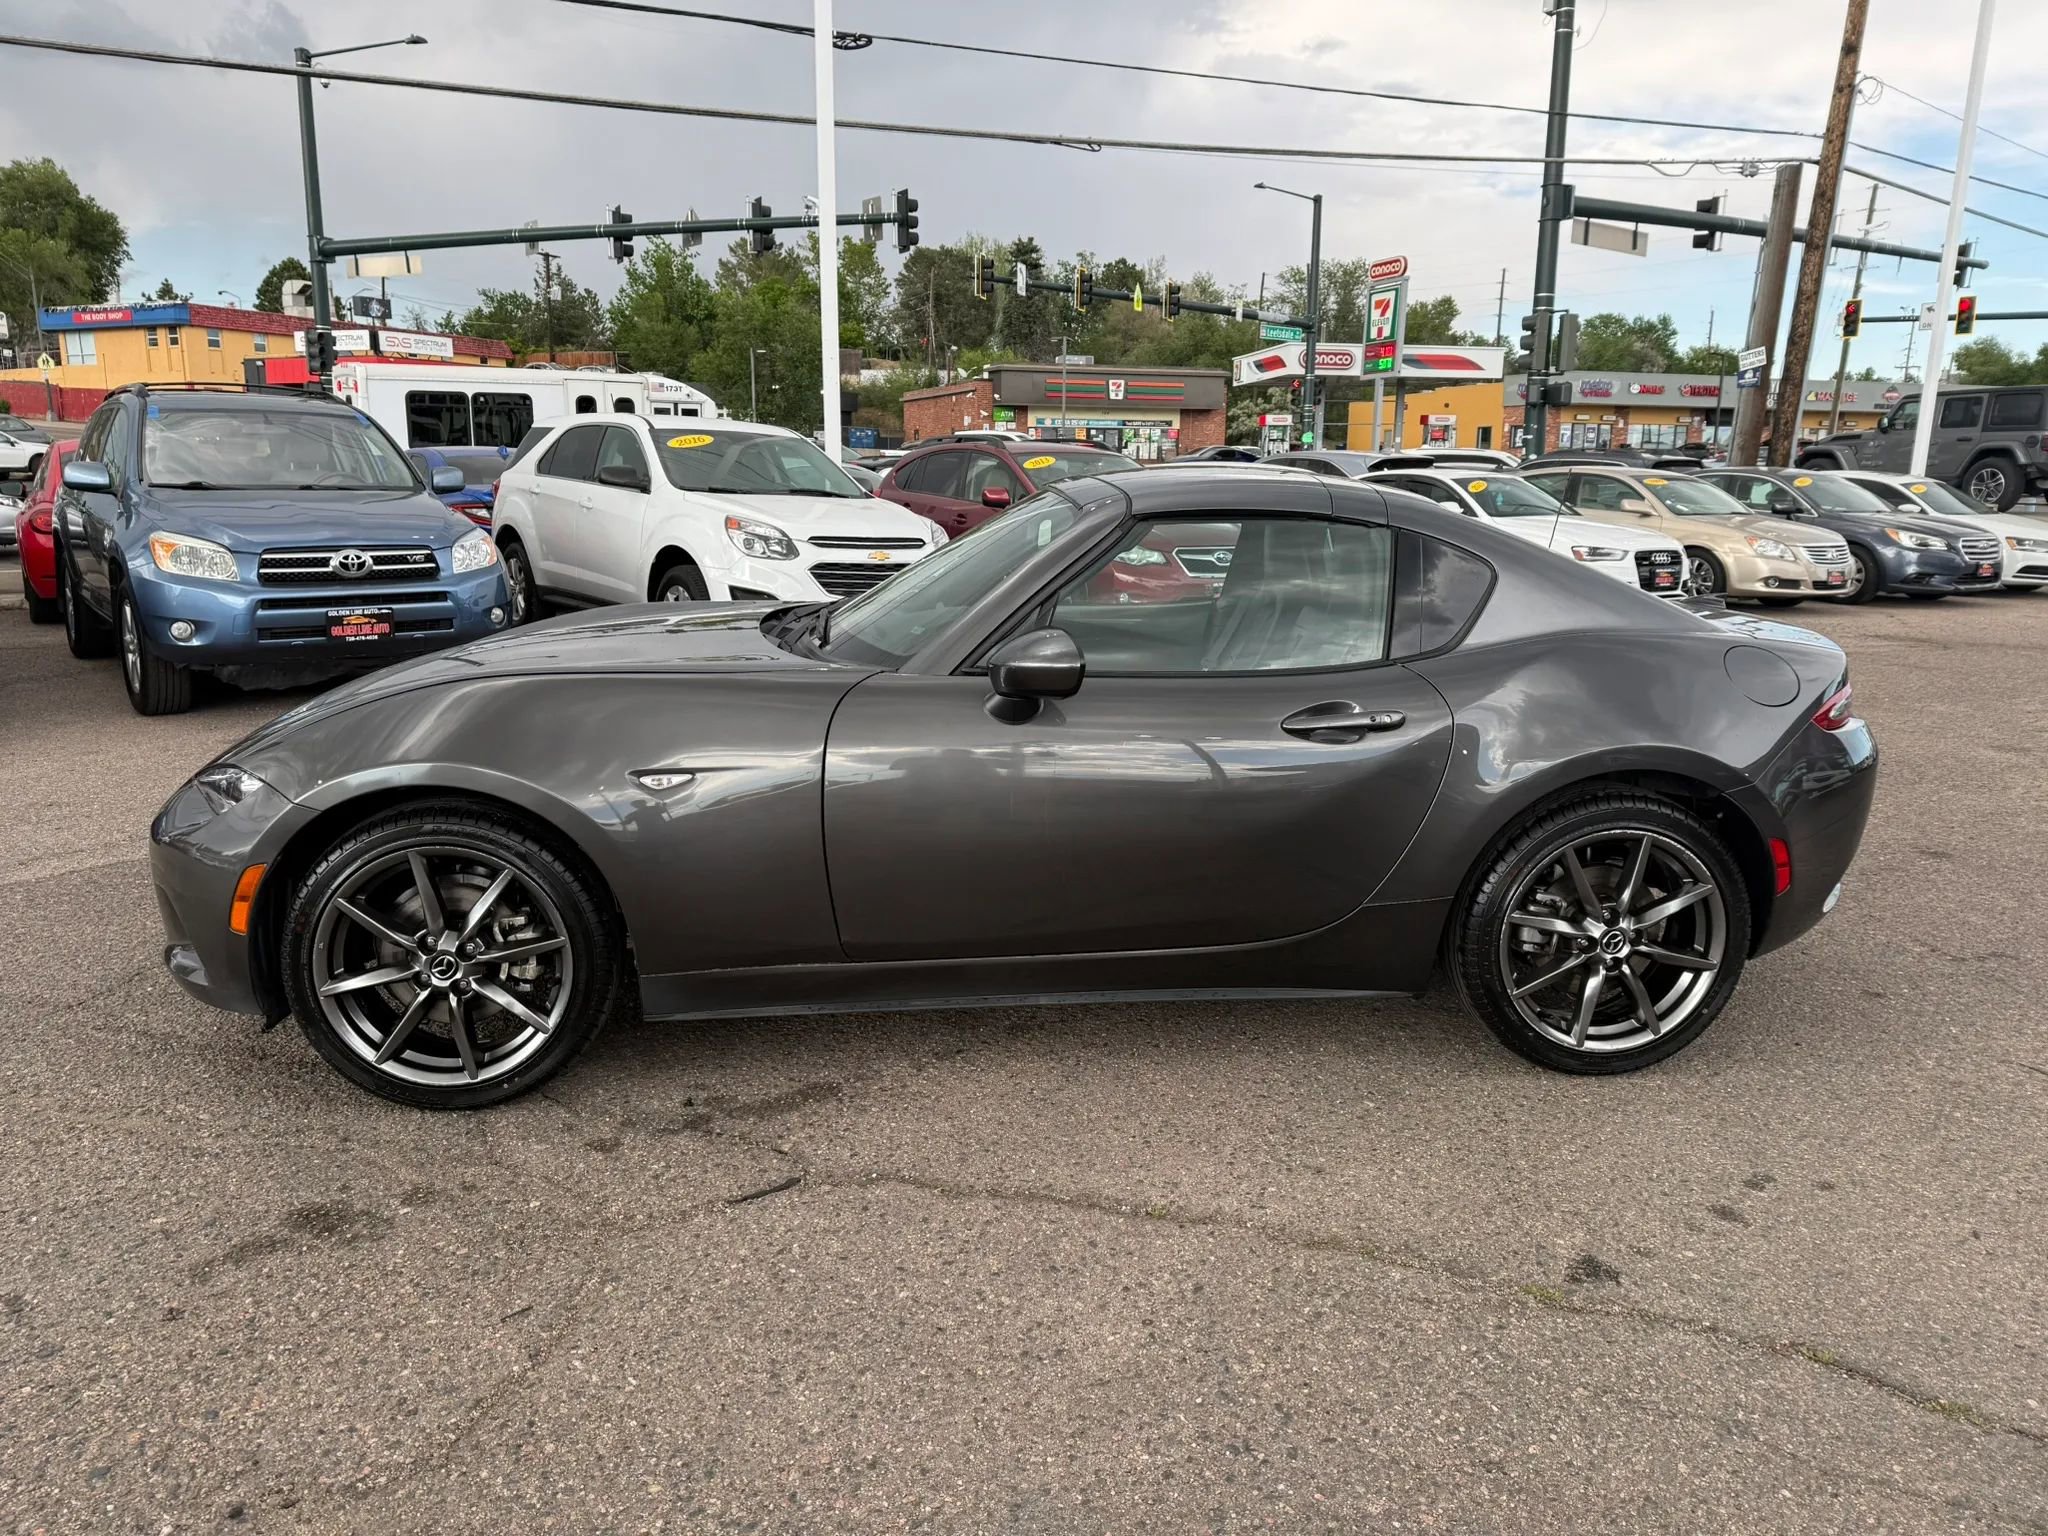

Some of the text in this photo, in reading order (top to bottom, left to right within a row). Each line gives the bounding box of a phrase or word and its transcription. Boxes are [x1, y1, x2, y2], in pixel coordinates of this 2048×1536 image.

[1372, 317, 1390, 328] ELEVEN
[413, 338, 448, 348] SPECTRUM
[1314, 353, 1352, 365] onoco
[665, 385, 683, 393] 173T
[676, 436, 706, 447] 2016
[407, 554, 425, 563] V6
[328, 609, 350, 617] GOLDEN
[350, 608, 363, 616] LINE
[330, 622, 391, 637] GOLDEN LINE AUTO
